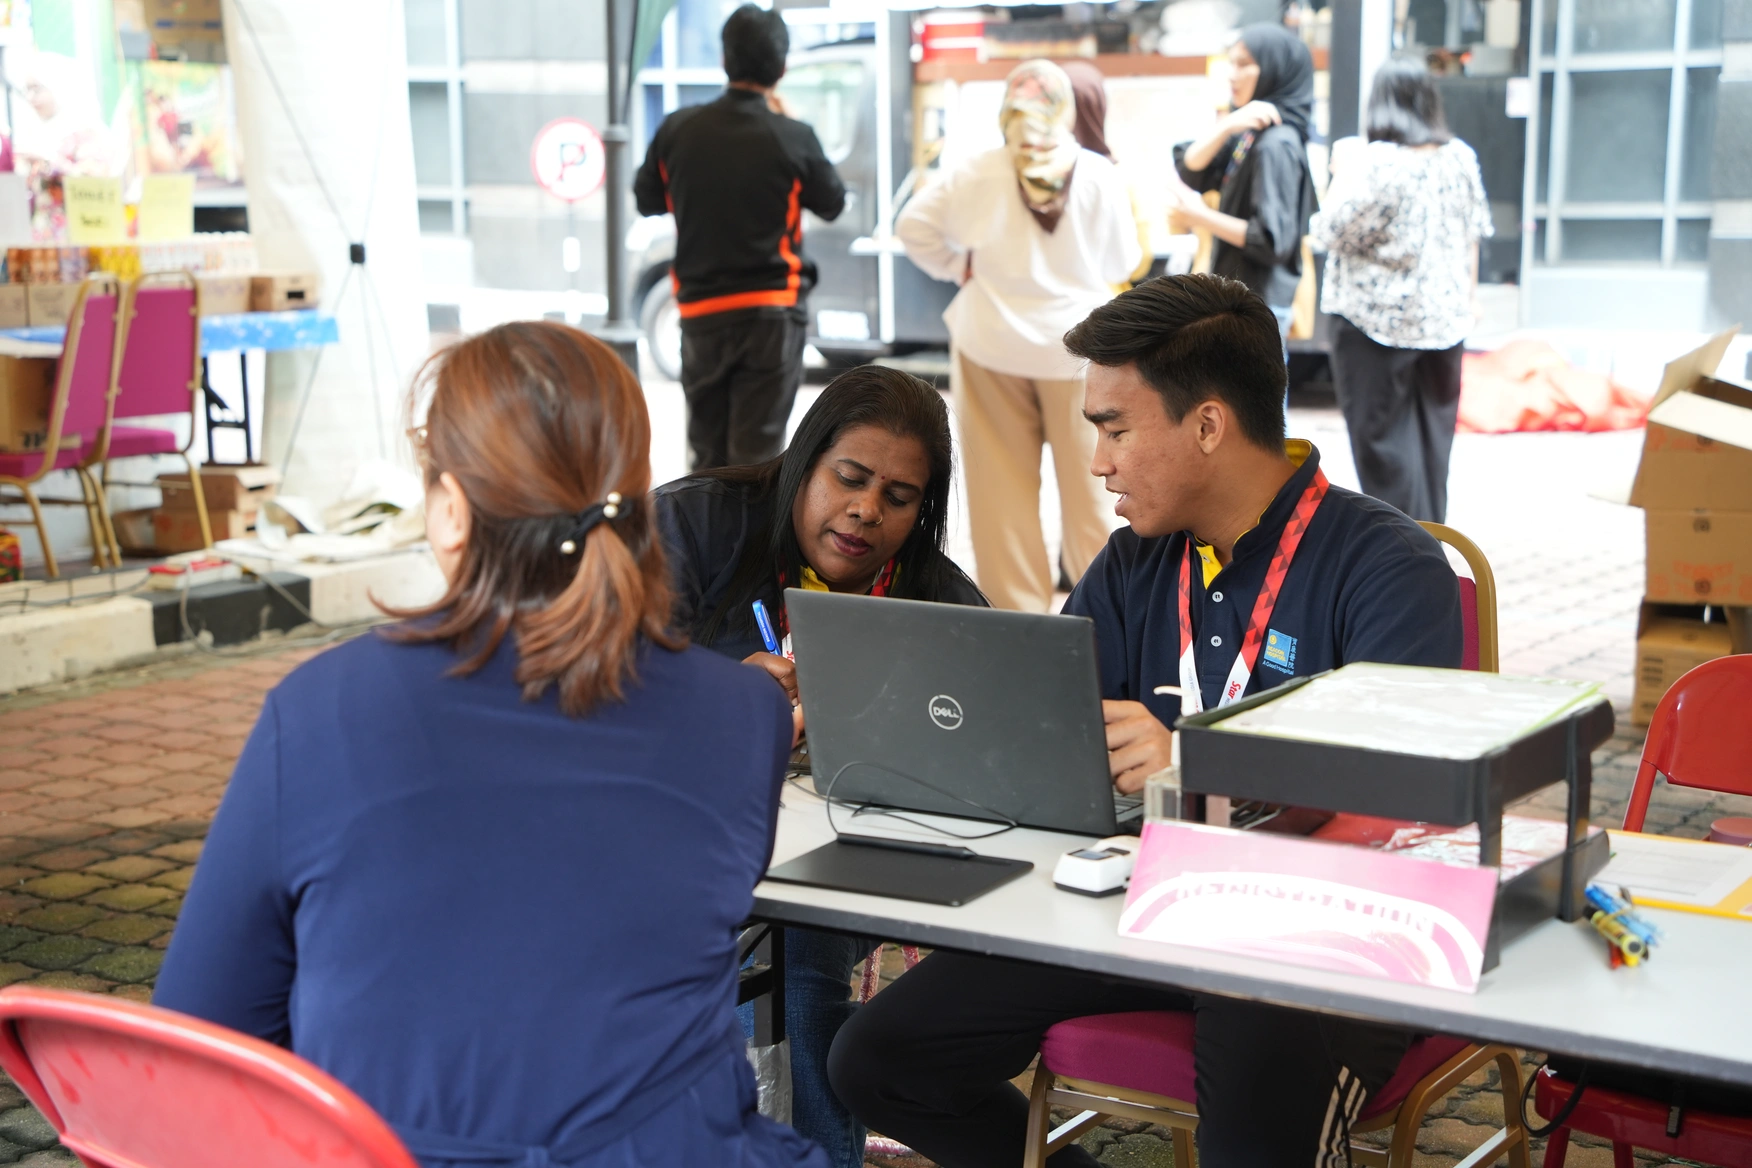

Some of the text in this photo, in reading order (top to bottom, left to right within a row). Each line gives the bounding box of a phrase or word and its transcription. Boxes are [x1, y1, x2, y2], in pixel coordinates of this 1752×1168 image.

[1267, 646, 1285, 655] BEACON
[1266, 651, 1287, 662] HOSPITAL
[1276, 665, 1294, 675] Hospital
[1228, 680, 1242, 700] Star
[933, 706, 960, 719] DELL
